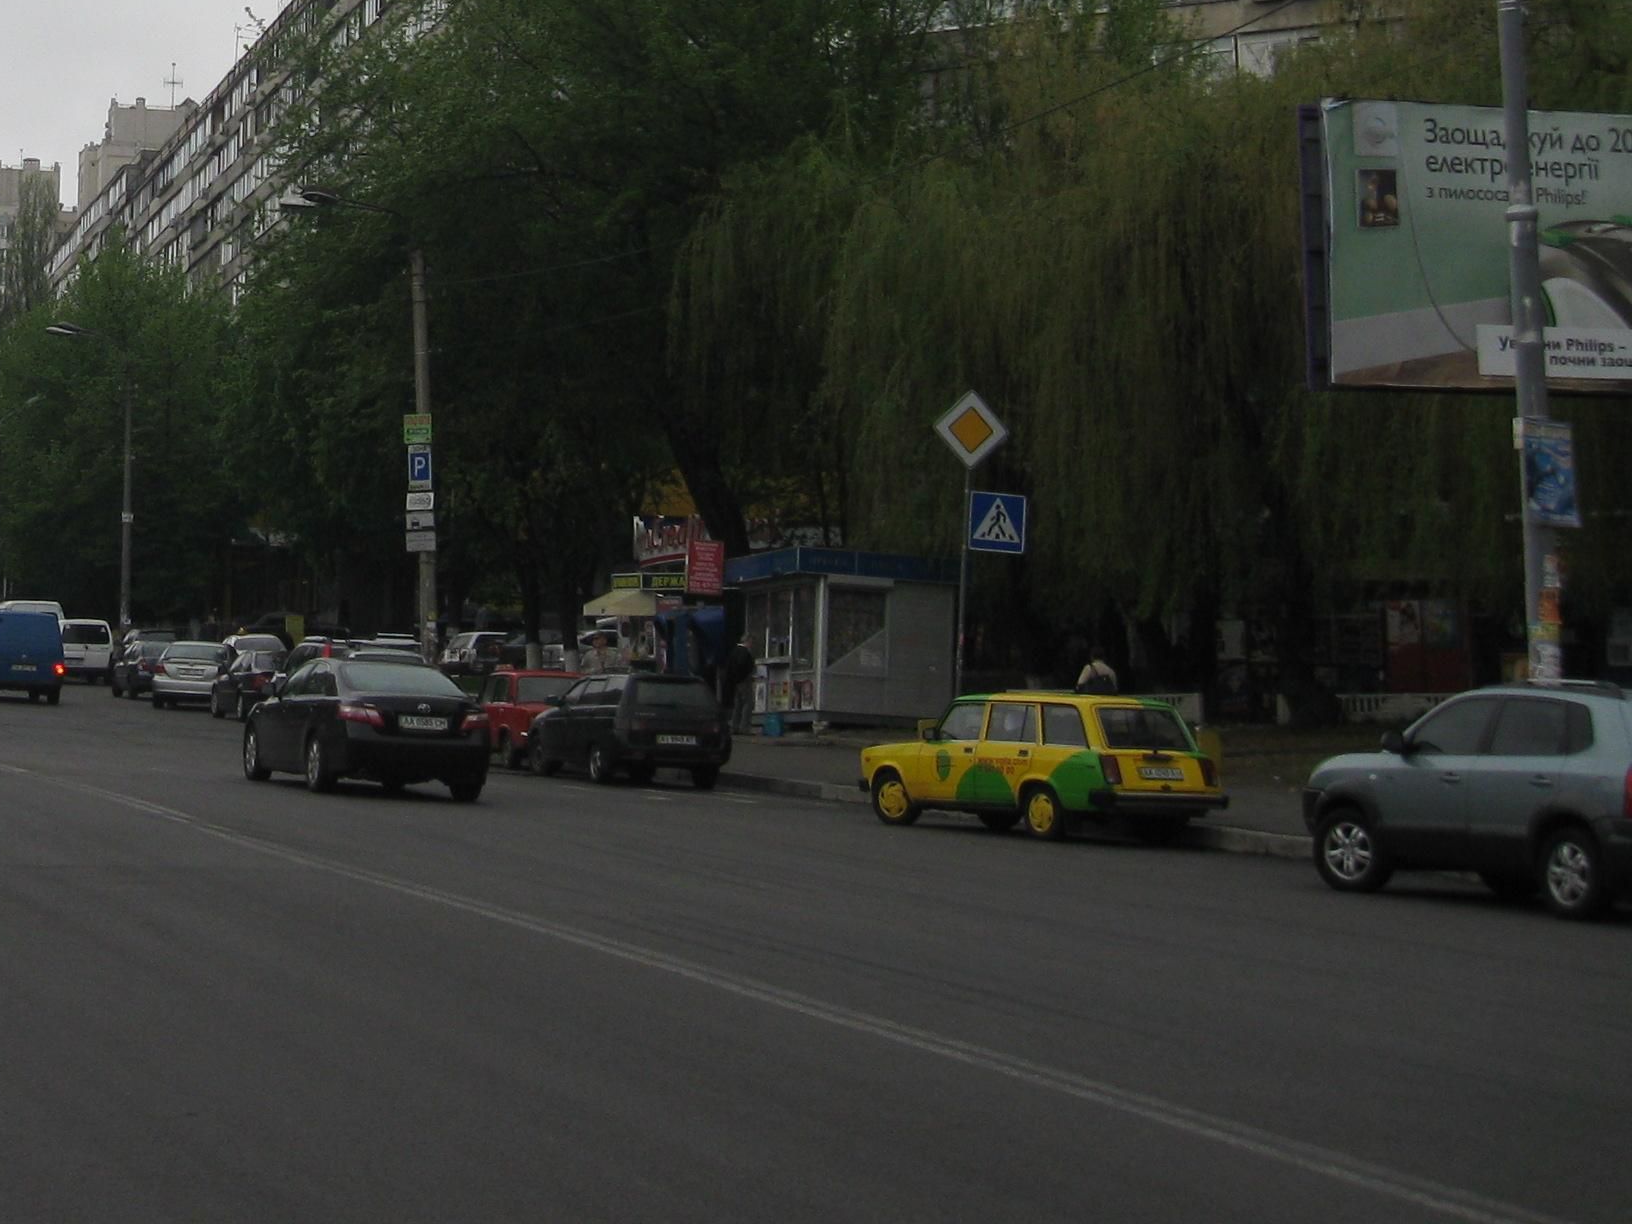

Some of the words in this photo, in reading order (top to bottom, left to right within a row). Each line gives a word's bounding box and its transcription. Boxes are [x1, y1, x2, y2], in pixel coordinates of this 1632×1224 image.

[1423, 118, 1562, 155] Заощауй
[1571, 132, 1600, 154] до
[1425, 155, 1600, 187] електрнергії
[1425, 187, 1434, 198] з
[1438, 187, 1510, 202] пилососа
[1536, 187, 1587, 210] Philips!
[1566, 338, 1614, 355] Philips
[1549, 355, 1595, 366] почни
[414, 456, 426, 477] P
